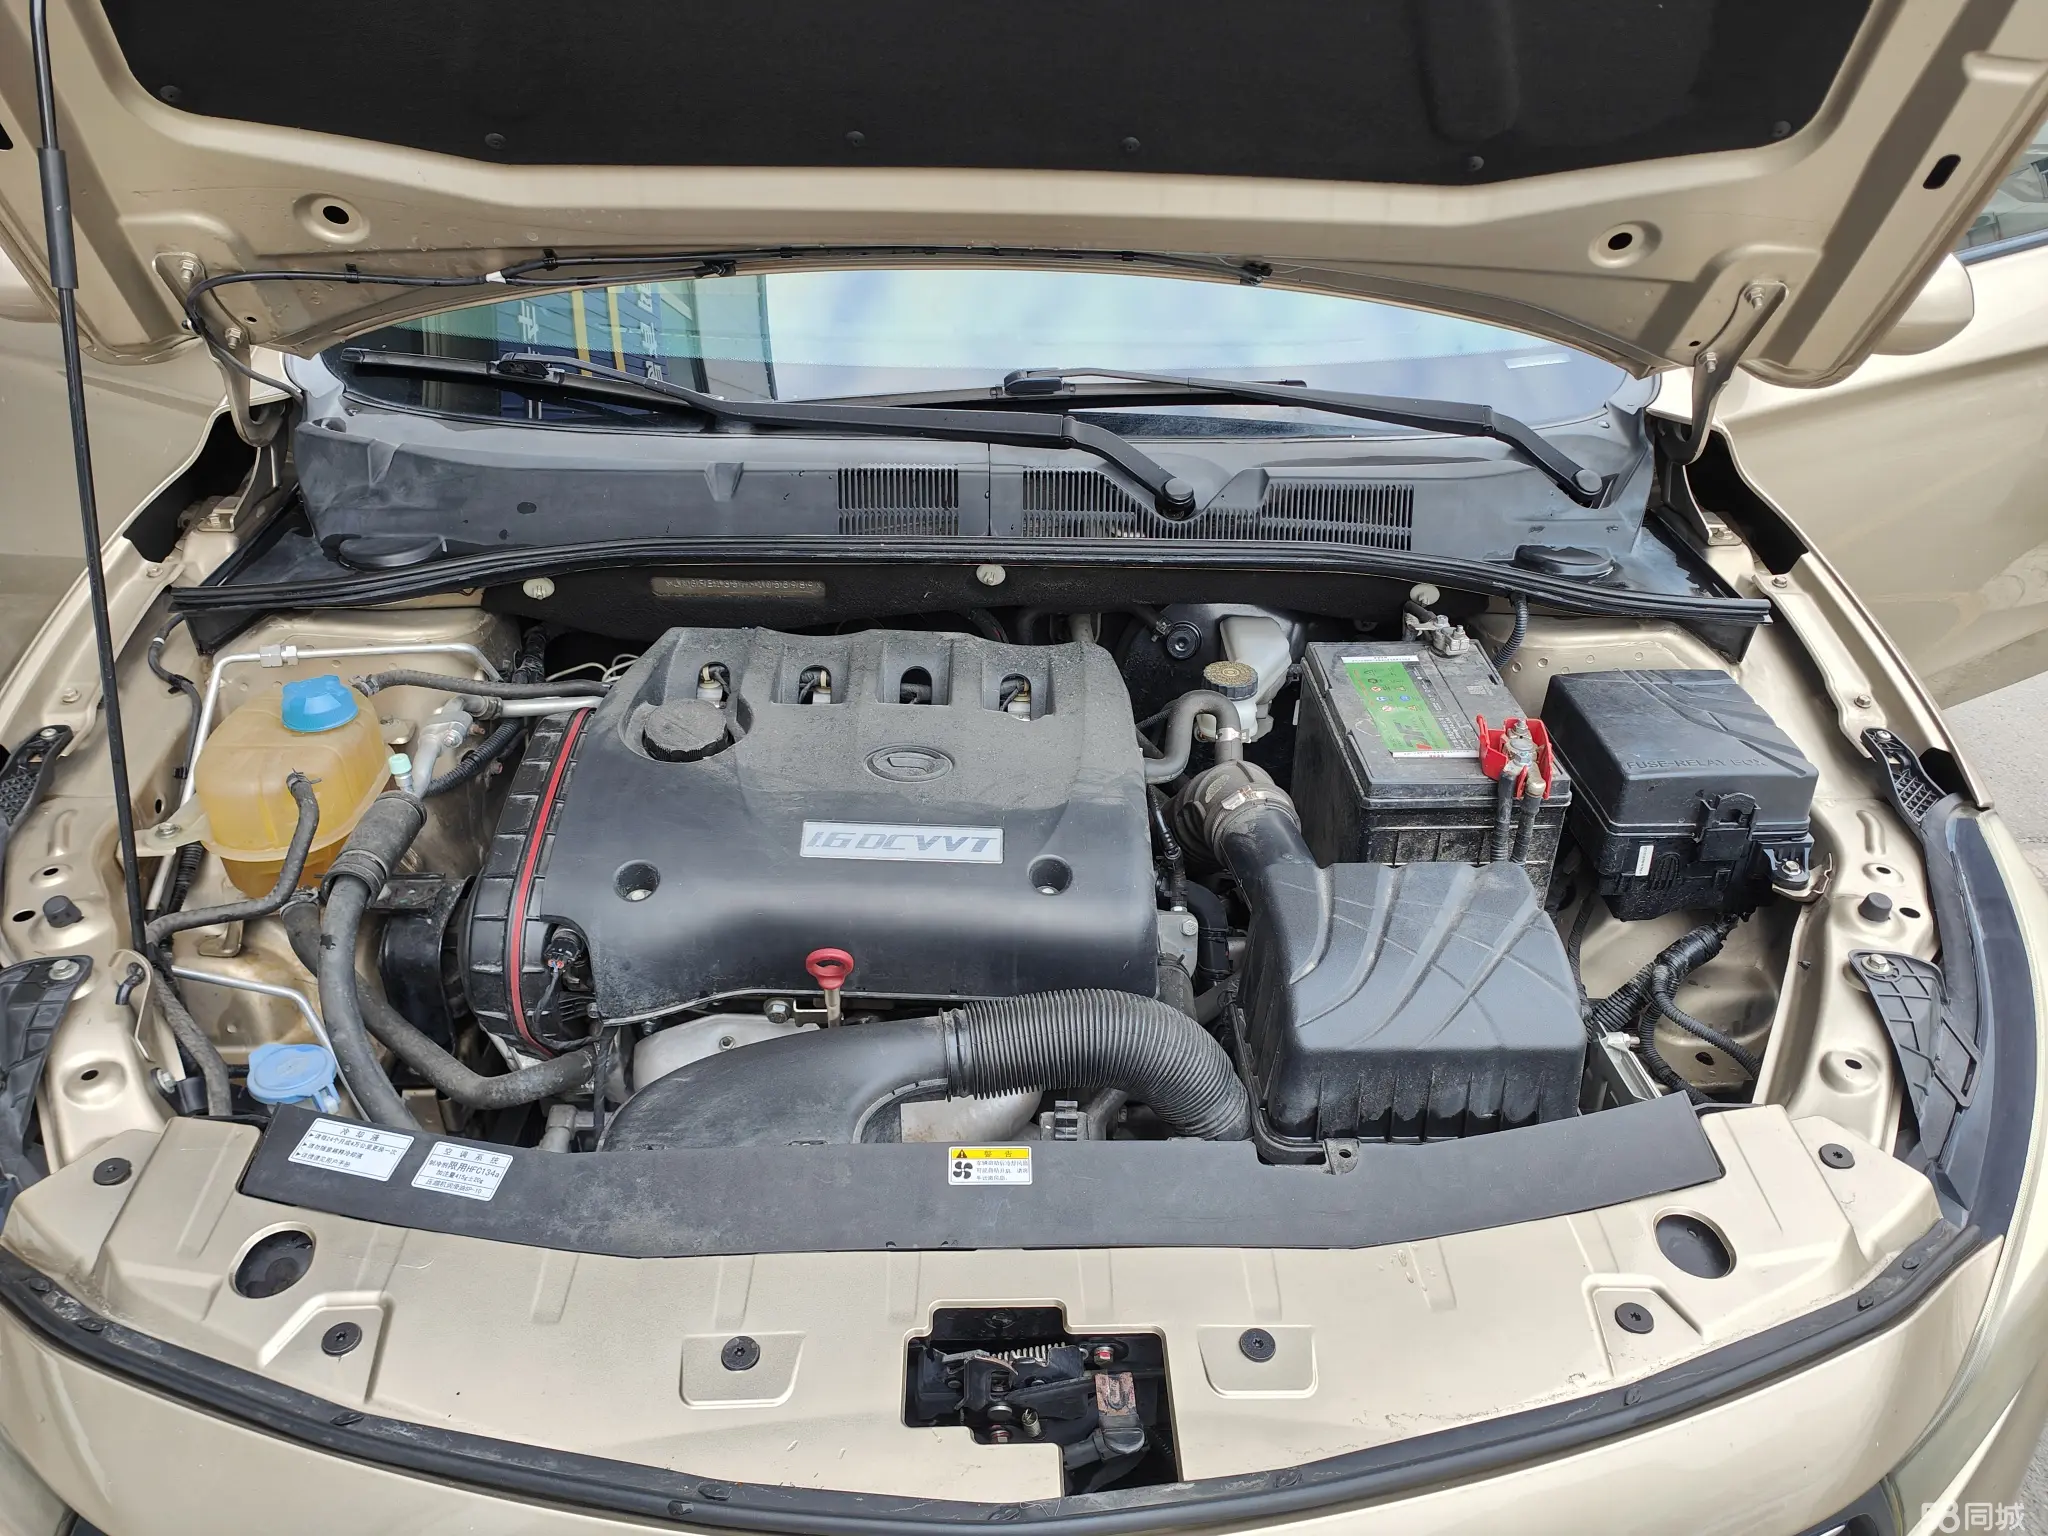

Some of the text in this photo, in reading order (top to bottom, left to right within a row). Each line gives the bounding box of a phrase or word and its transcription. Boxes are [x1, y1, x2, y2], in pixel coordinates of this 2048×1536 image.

[1627, 759, 1727, 770] FUSE-RELAY
[806, 831, 998, 853] 1.6 DCVVT
[340, 1128, 380, 1141] 冷却液
[443, 1148, 500, 1165] 空调系统
